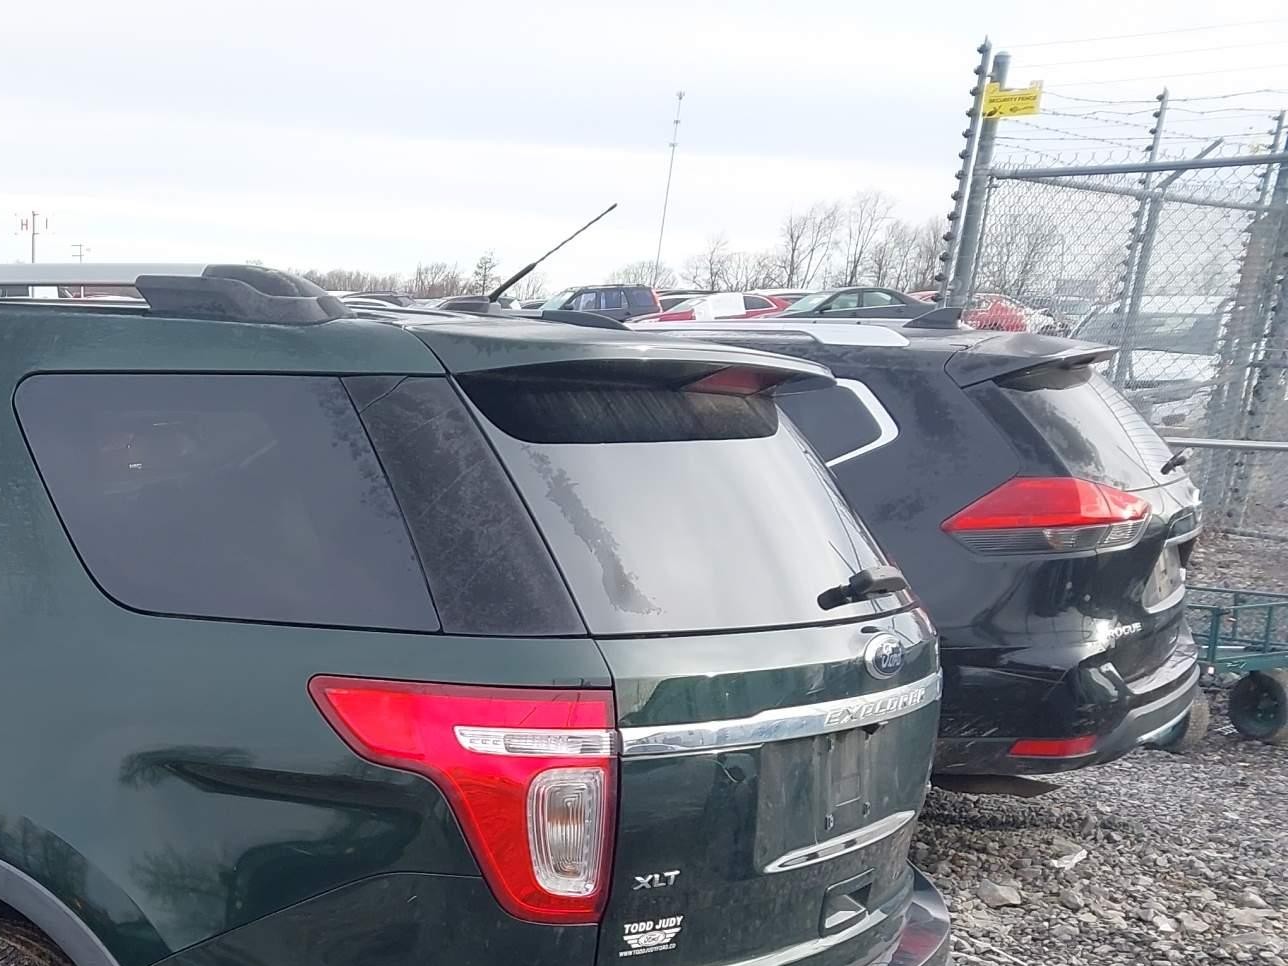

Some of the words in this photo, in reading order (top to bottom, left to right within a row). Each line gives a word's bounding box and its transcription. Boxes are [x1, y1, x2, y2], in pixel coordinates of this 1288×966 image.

[824, 687, 926, 727] EXPLORER
[633, 870, 680, 890] XLT
[624, 920, 654, 935] TODD
[655, 915, 684, 930] JUDY
